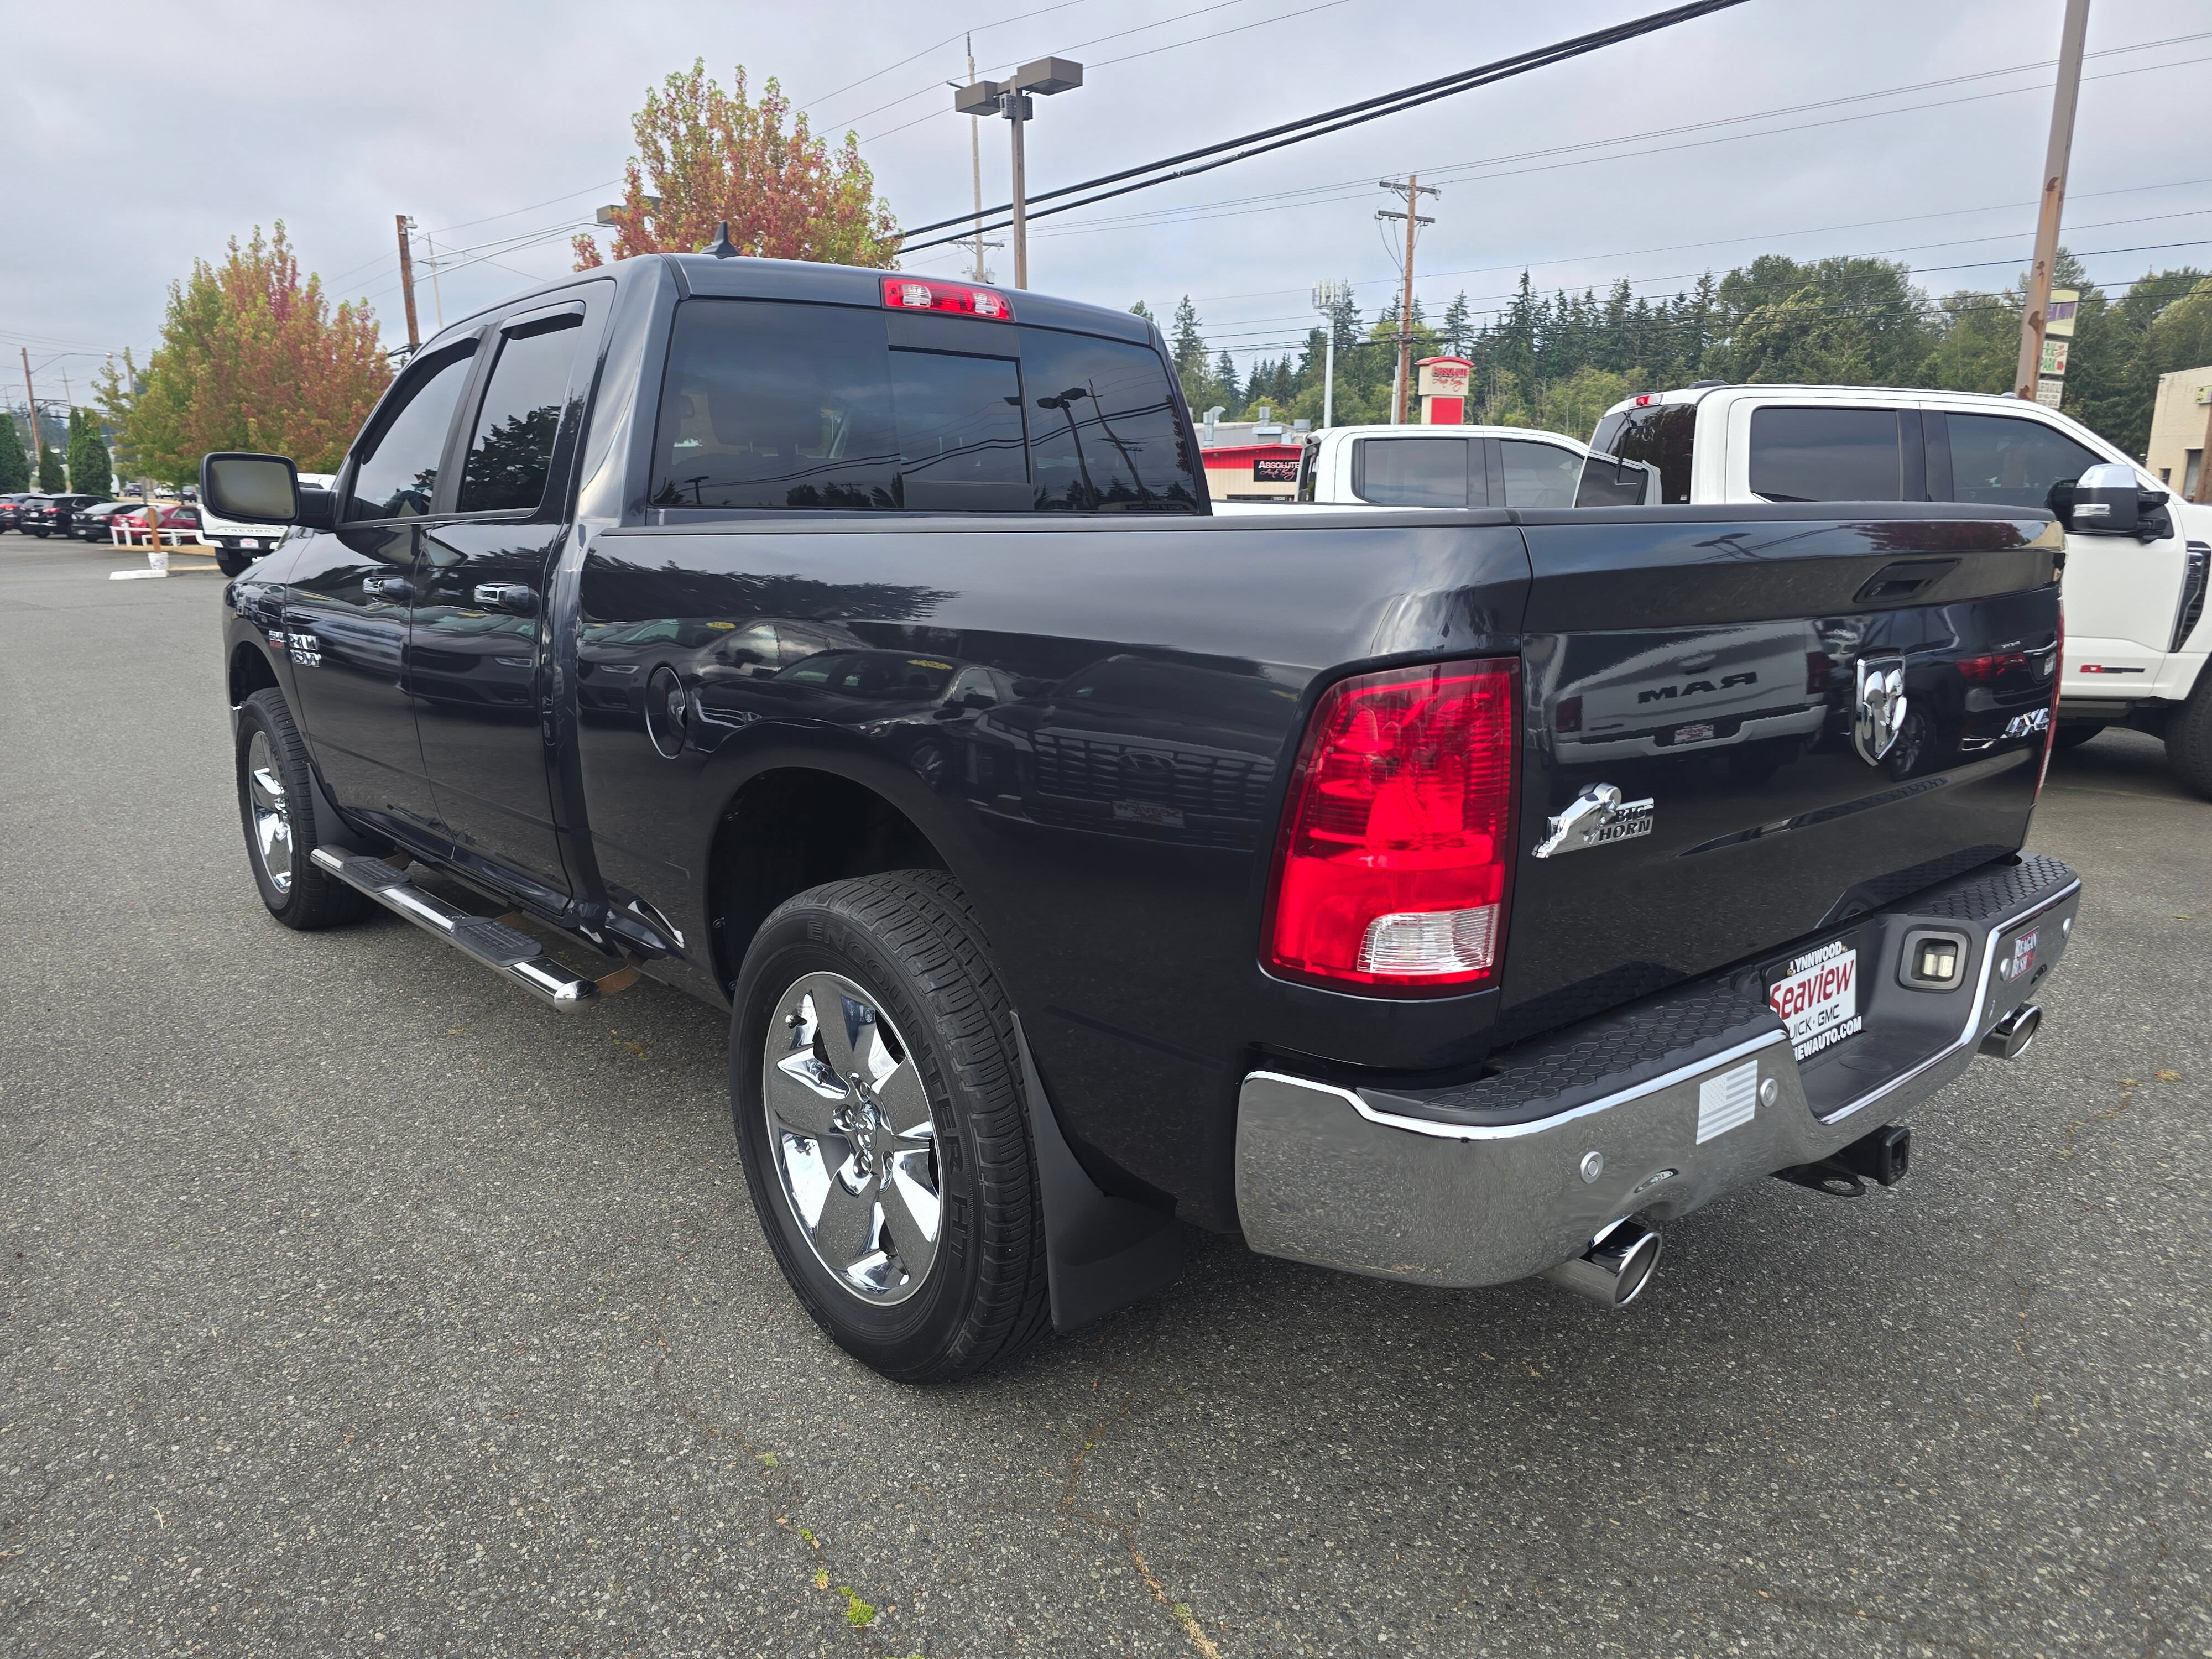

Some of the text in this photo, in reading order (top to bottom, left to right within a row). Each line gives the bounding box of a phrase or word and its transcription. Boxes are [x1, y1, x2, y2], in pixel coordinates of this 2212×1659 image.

[1431, 366, 1469, 377] ABSOLUTE
[1258, 461, 1300, 469] ABSOLUTE
[1614, 805, 1646, 824] BIG
[1598, 819, 1651, 841] HORN
[1790, 941, 1842, 975] LYNNWOOD
[1771, 959, 1854, 1020] Seaview
[1788, 1003, 1840, 1041] UICK GMC
[1793, 1016, 1861, 1061] IEWAUTO.COM
